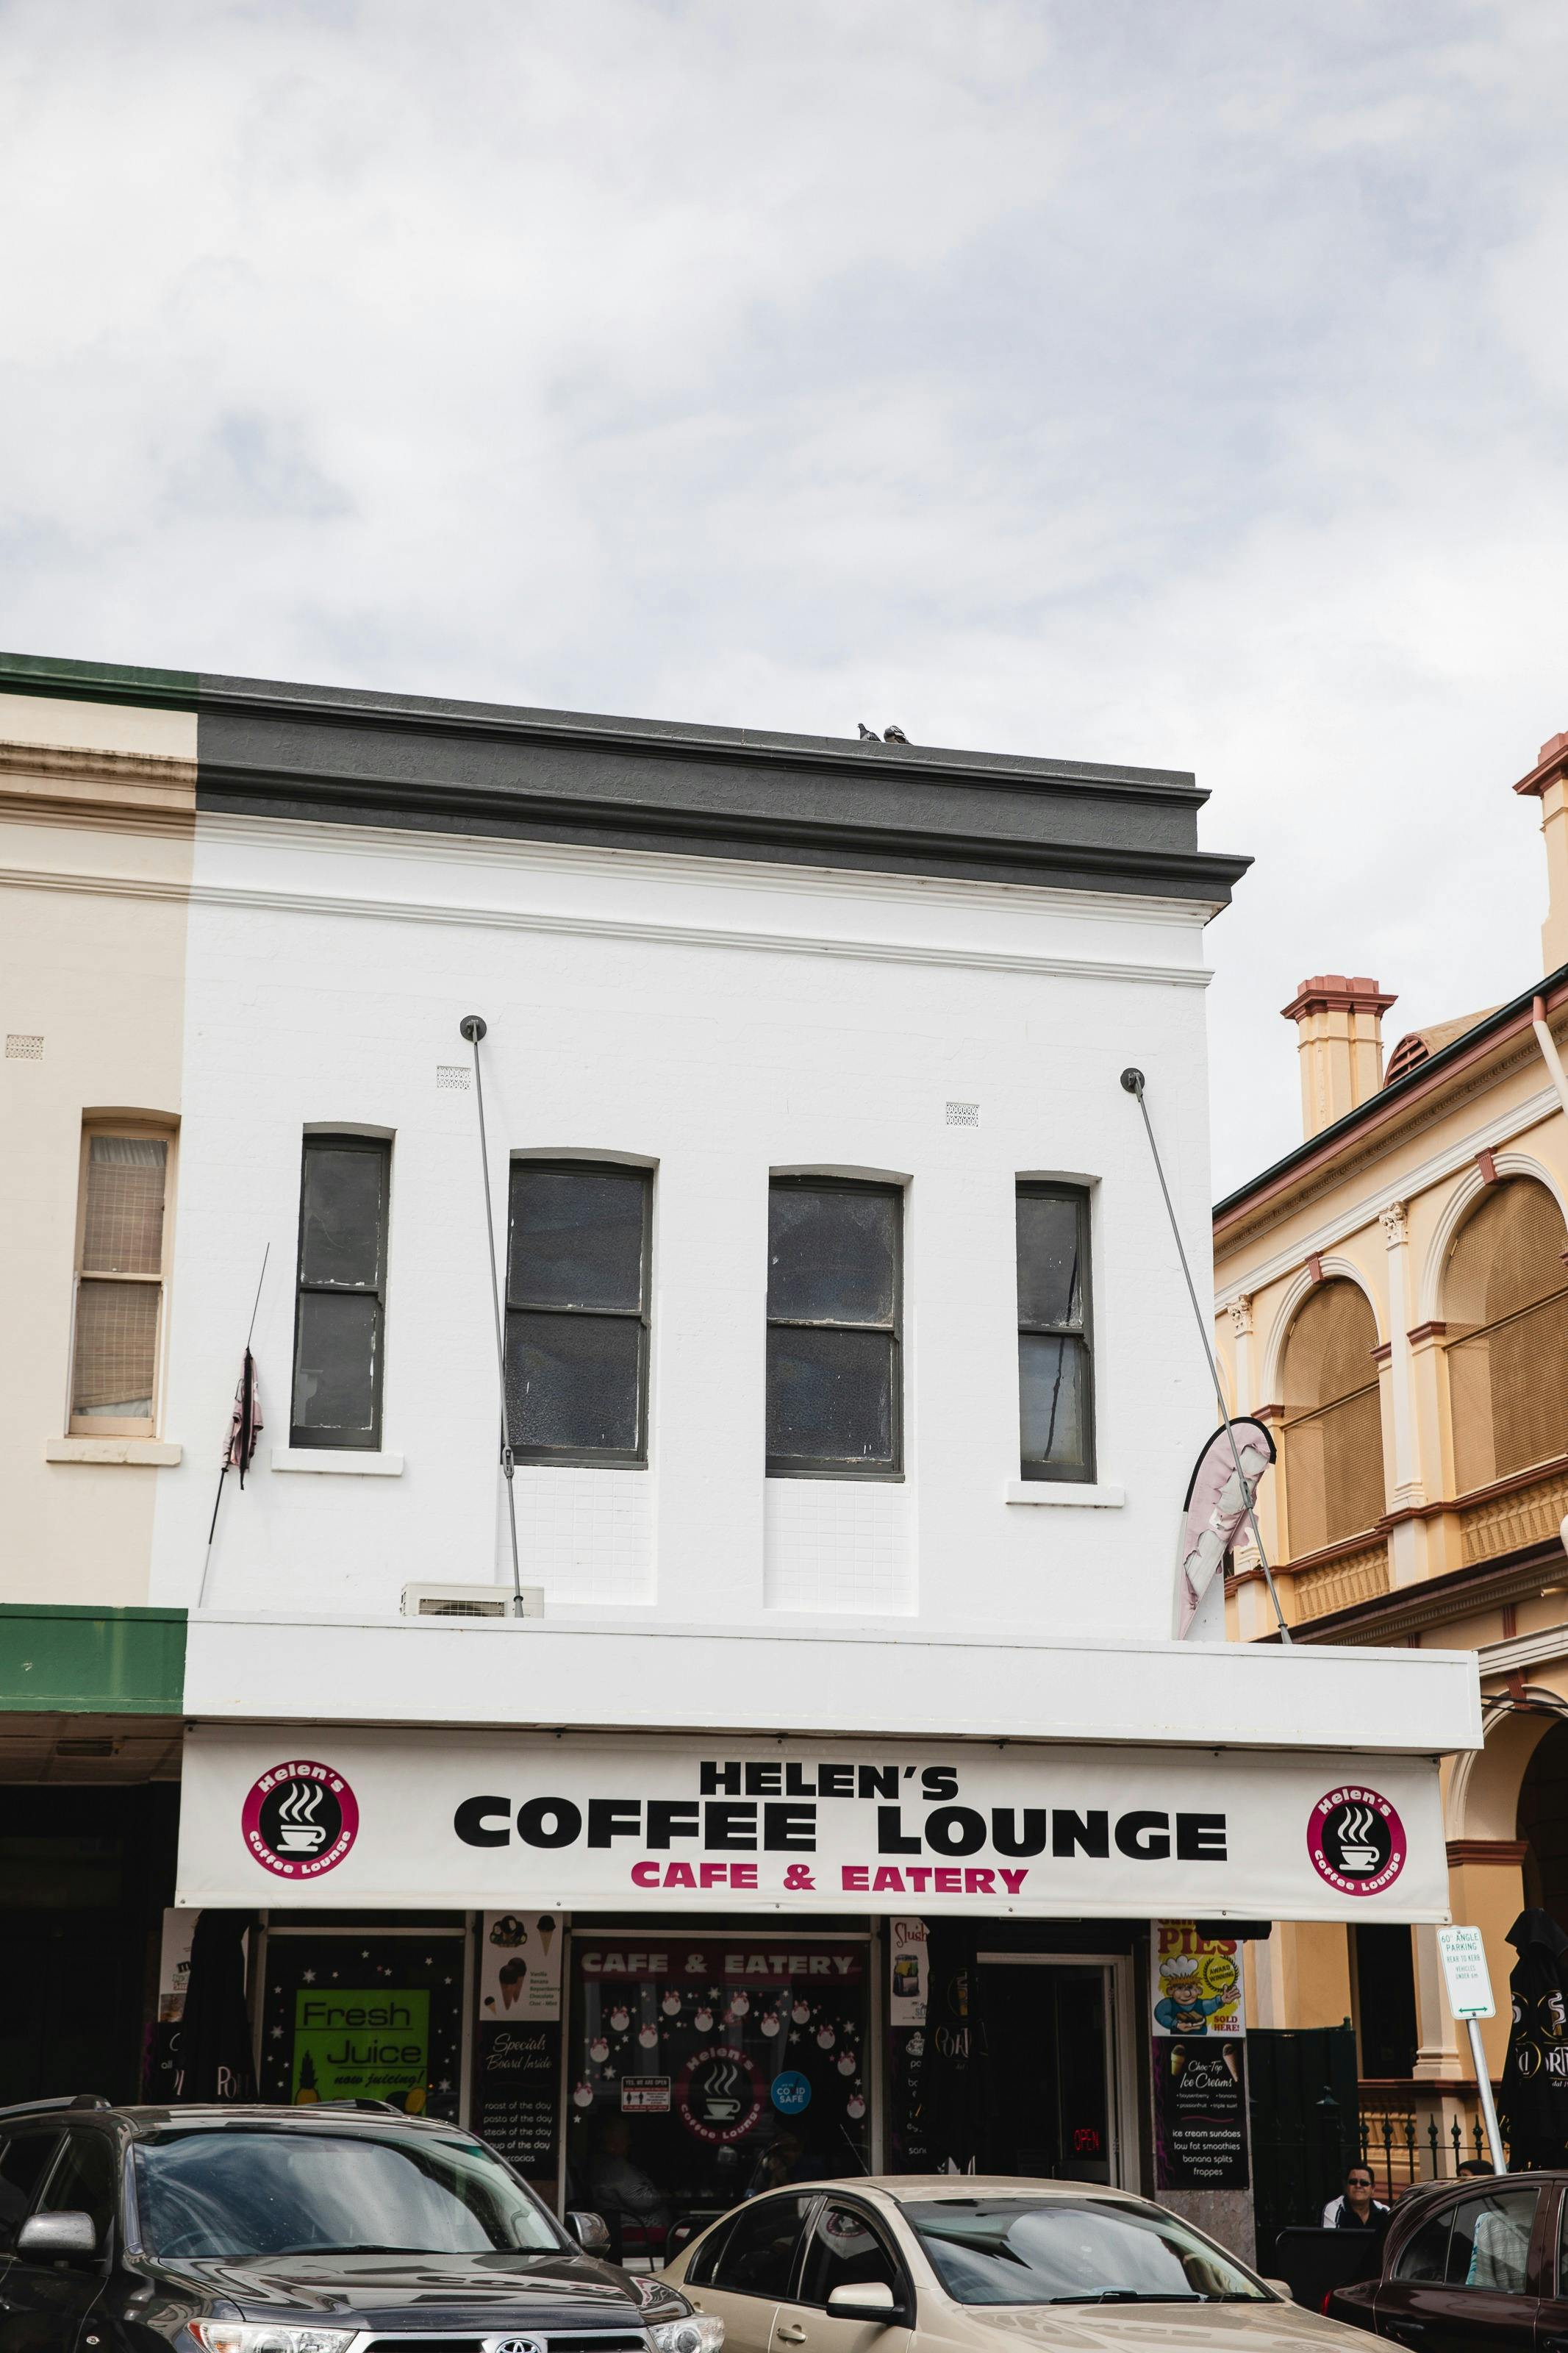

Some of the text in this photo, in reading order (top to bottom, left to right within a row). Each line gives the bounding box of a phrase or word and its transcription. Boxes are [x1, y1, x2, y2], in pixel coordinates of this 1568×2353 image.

[258, 1764, 344, 1793] Helen's
[701, 1762, 959, 1801] HELEN'S
[1318, 1789, 1392, 1816] Helen's
[454, 1796, 1228, 1862] COFFEE LOUNGE
[249, 1831, 351, 1874] Coffee Lounge
[631, 1861, 1029, 1894] CAFE & EATERY
[1314, 1850, 1400, 1891] Coffee Lounge
[1158, 1928, 1237, 1956] PIES
[1456, 1933, 1479, 1942] ANGLE
[1446, 1943, 1477, 1952] PARKING
[581, 1952, 854, 1975] CAFE & EATERY
[1210, 1964, 1231, 1976] AWARD
[1209, 1971, 1234, 1982] WINNING
[304, 2002, 410, 2027] Fresh
[1214, 2015, 1237, 2024] SOLD
[1214, 2024, 1239, 2032] HERE!
[327, 2039, 422, 2064] Juice
[493, 2032, 546, 2057] Specials
[486, 2054, 552, 2071] Board Inside
[686, 2047, 754, 2071] Helen's
[1188, 2060, 1223, 2075] Choc-Top
[334, 2070, 425, 2088] now juicing!
[1180, 2072, 1233, 2088] Ice Creams
[508, 2101, 518, 2110] of
[519, 2102, 533, 2110] the
[535, 2102, 552, 2111] day
[779, 2095, 804, 2104] SAFE
[483, 2115, 553, 2125] pasta of the day
[681, 2103, 761, 2139] Coffee Lounge
[484, 2127, 551, 2138] steak of the day
[1073, 2129, 1100, 2152] OPEN
[1173, 2129, 1183, 2138] ice
[1209, 2129, 1241, 2138] sundaes
[490, 2140, 550, 2152] oup of the day
[1174, 2141, 1240, 2150] low fat smoothies
[1183, 2154, 1233, 2164] banana splits
[1193, 2166, 1223, 2178] frappes
